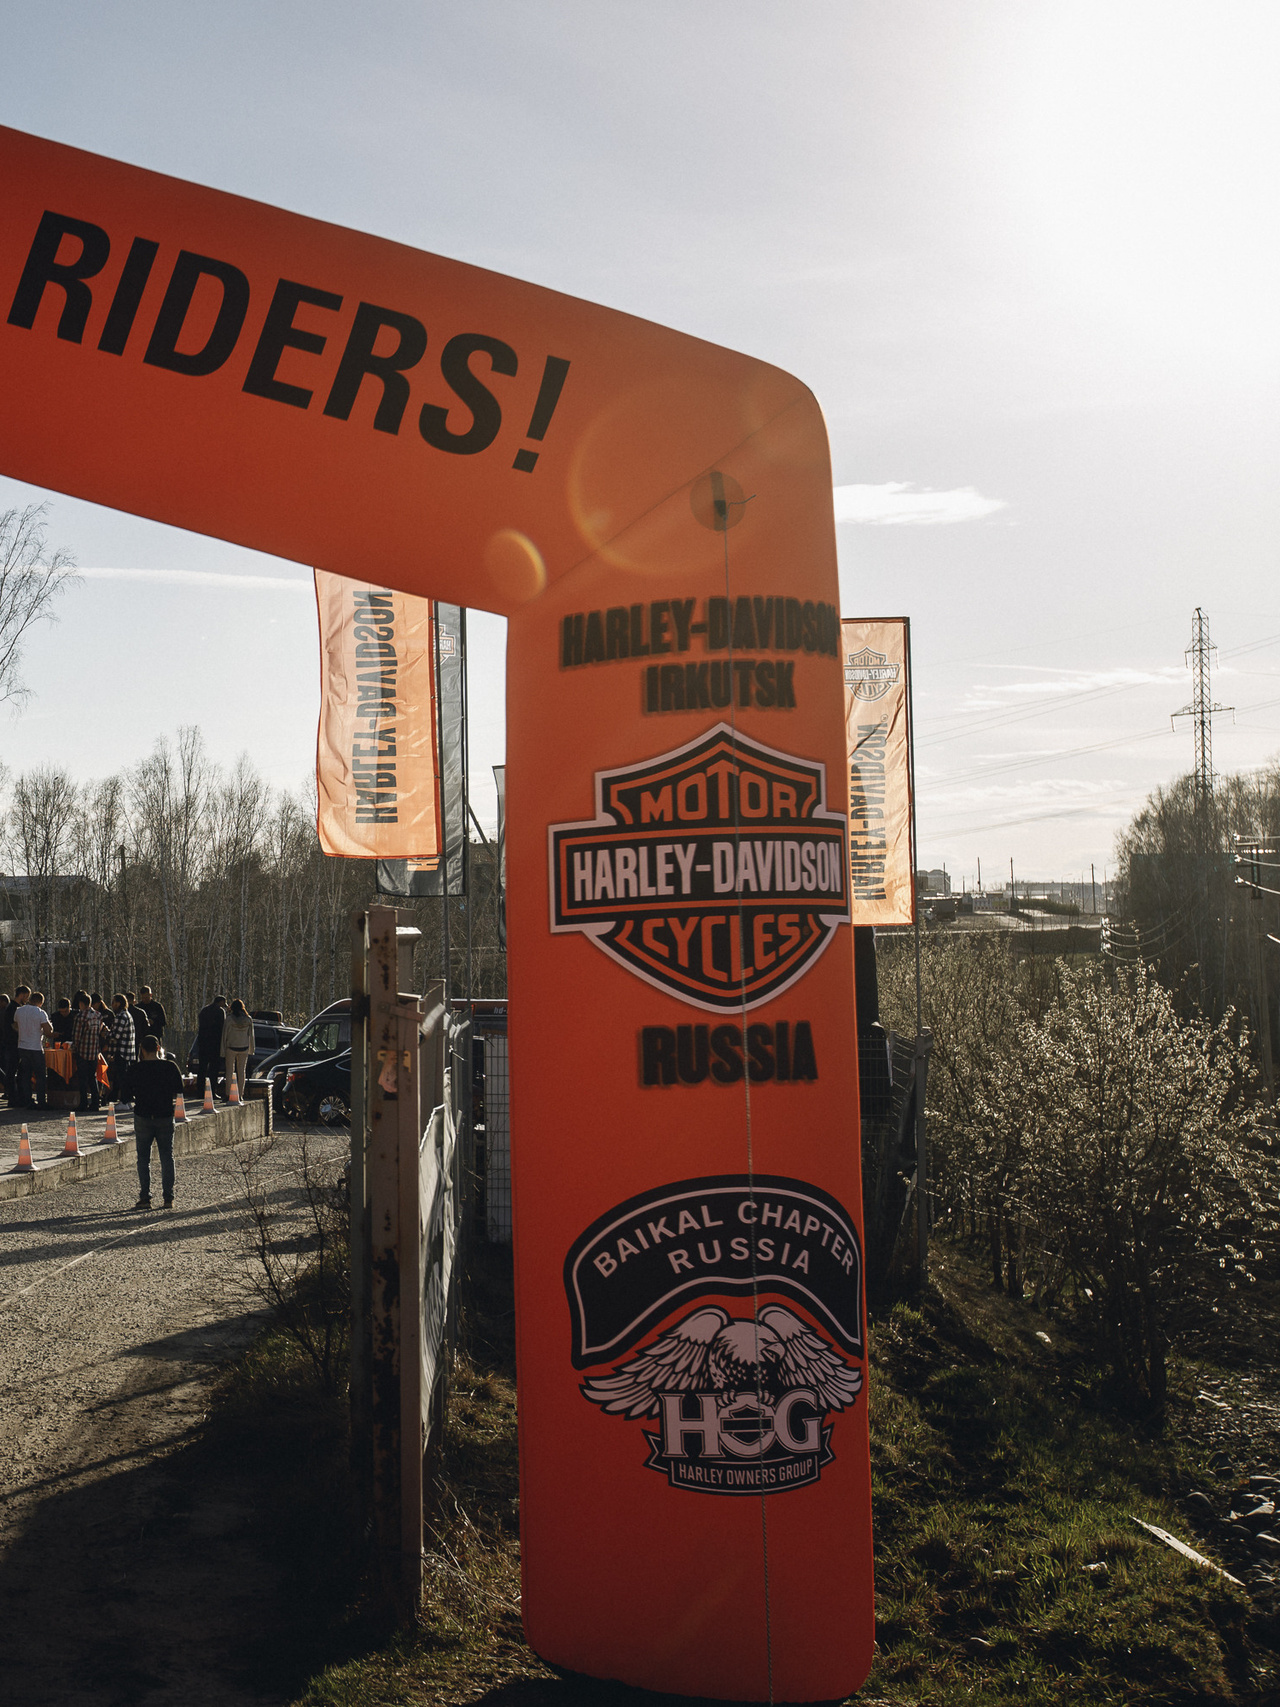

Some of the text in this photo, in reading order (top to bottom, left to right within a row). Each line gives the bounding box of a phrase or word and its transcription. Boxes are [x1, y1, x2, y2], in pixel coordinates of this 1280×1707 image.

[7, 210, 570, 473] RIDERS!
[562, 596, 839, 667] HARLEY-DAVIDSON
[644, 659, 796, 713] IRKUTSK
[640, 759, 797, 823] MOTOR
[573, 841, 841, 901] HARLEY-DAVIDSON
[642, 914, 800, 982] CYCLES
[639, 1021, 819, 1087] RUSSIA
[593, 1201, 853, 1278] BAIKAL CHAPTER
[667, 1238, 809, 1274] RUSSIA
[659, 1388, 822, 1458] HOG
[679, 1459, 812, 1485] HARLEY OWNERS GROUP
